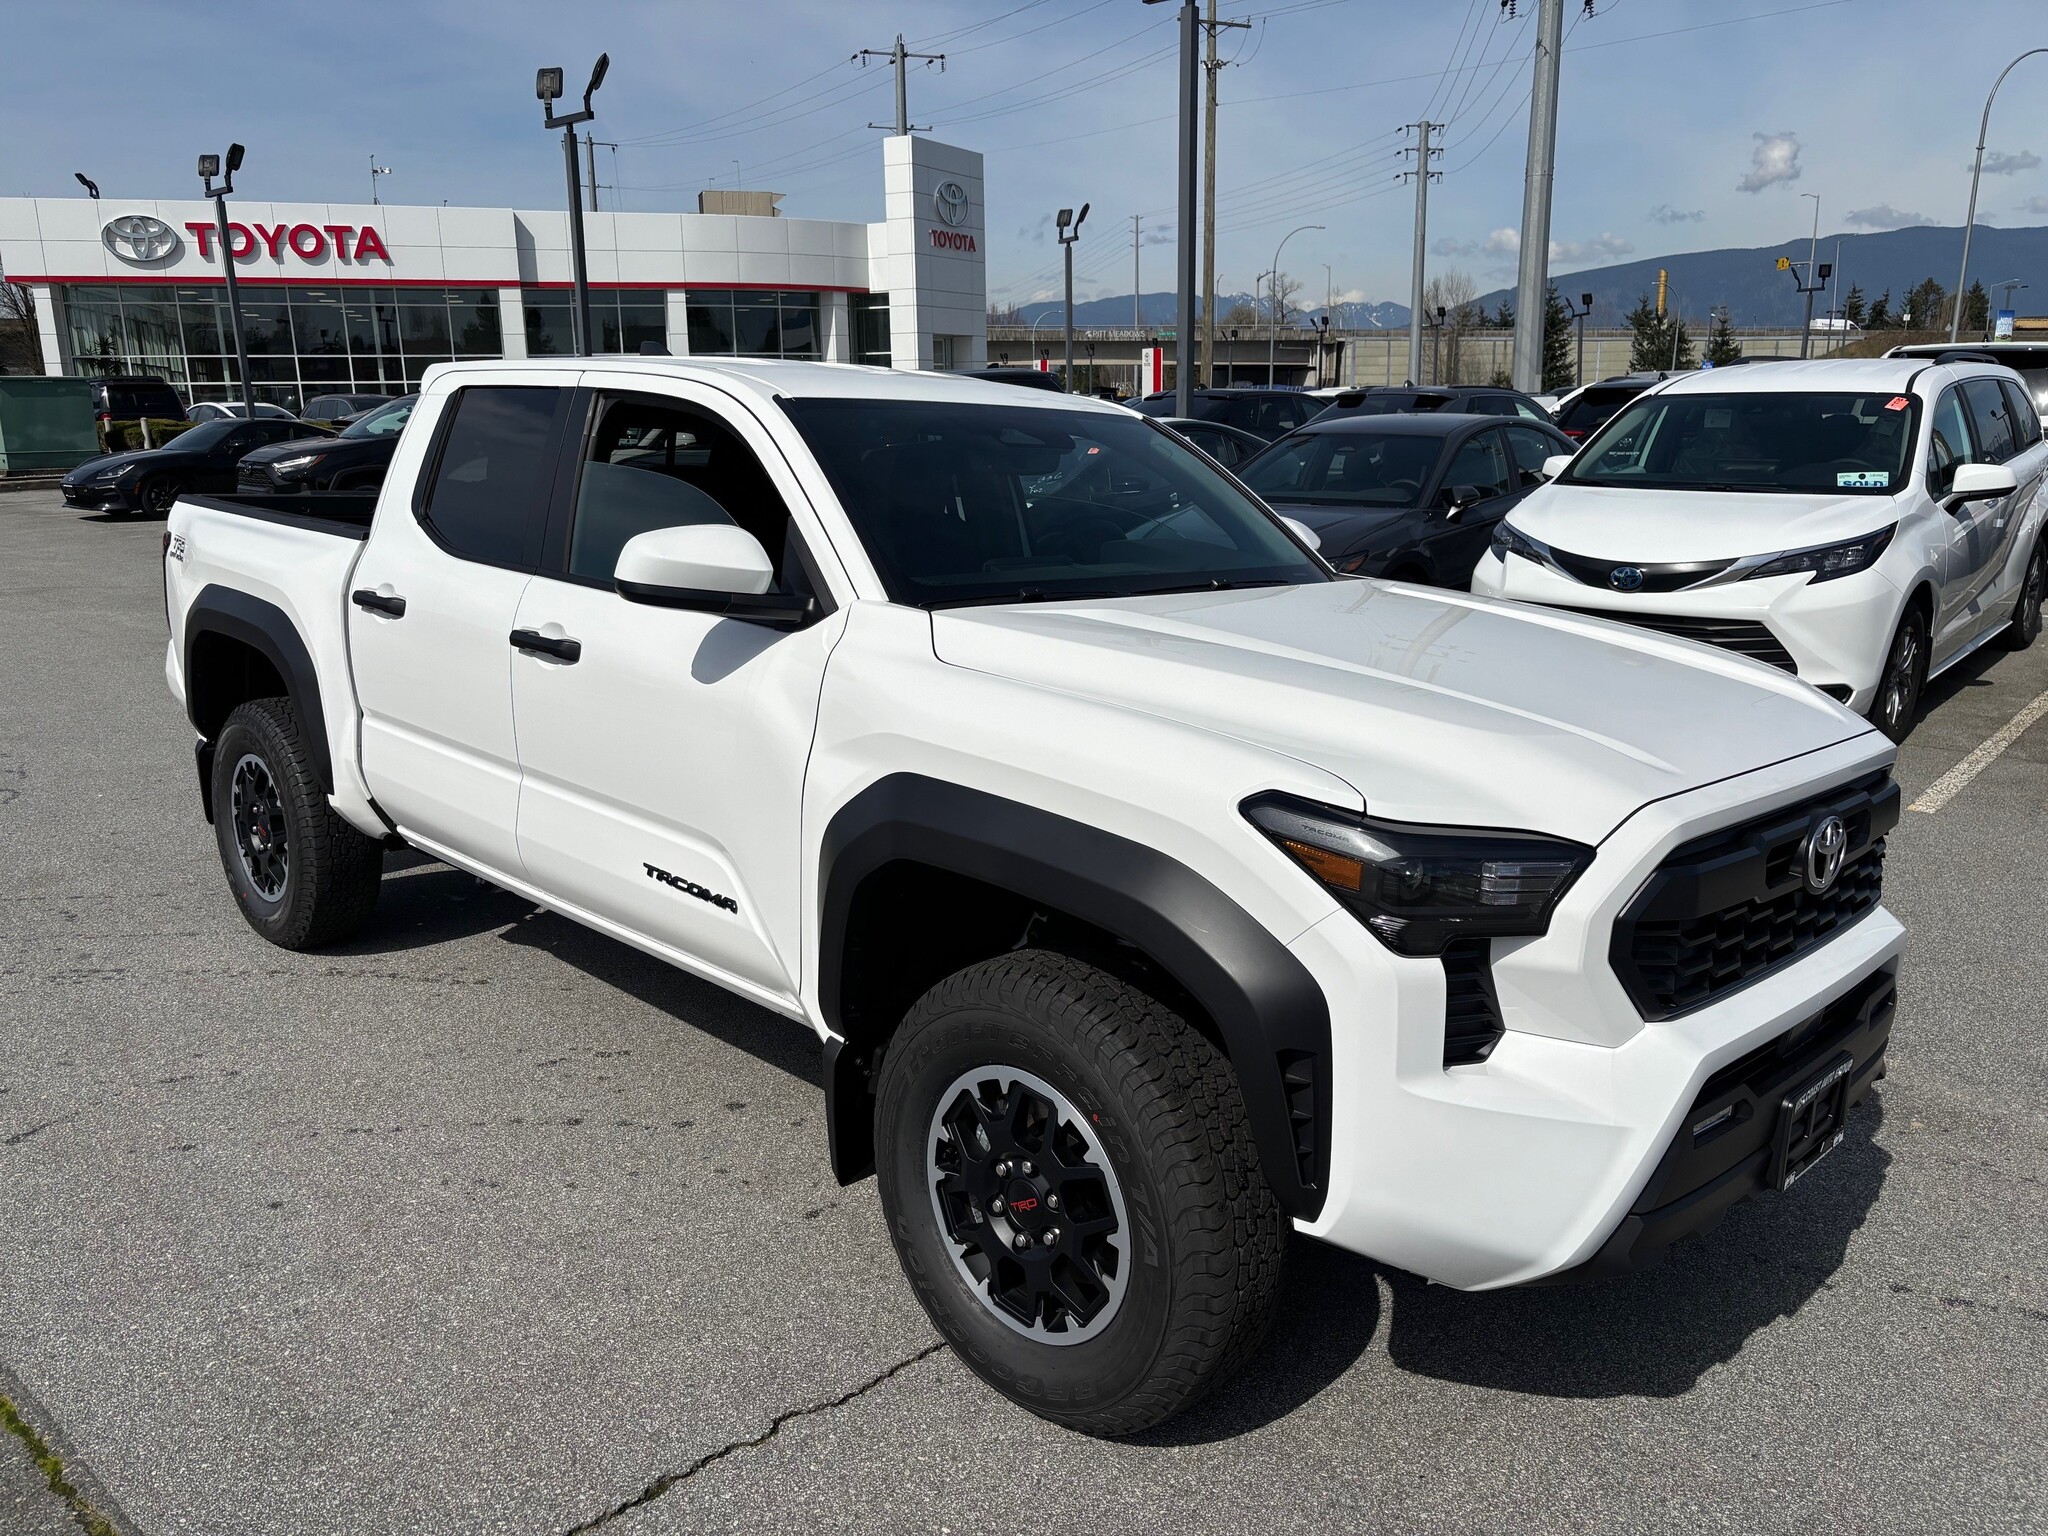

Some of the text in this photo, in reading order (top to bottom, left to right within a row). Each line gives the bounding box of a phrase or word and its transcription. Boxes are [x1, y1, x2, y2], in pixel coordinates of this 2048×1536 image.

[184, 222, 390, 259] TOYOTA
[930, 229, 976, 252] TOYOTA
[1092, 330, 1146, 338] PITT MEADOWS
[1301, 824, 1350, 842] TACOMA
[642, 861, 738, 915] TACOMA
[1010, 1198, 1037, 1213] TRD
